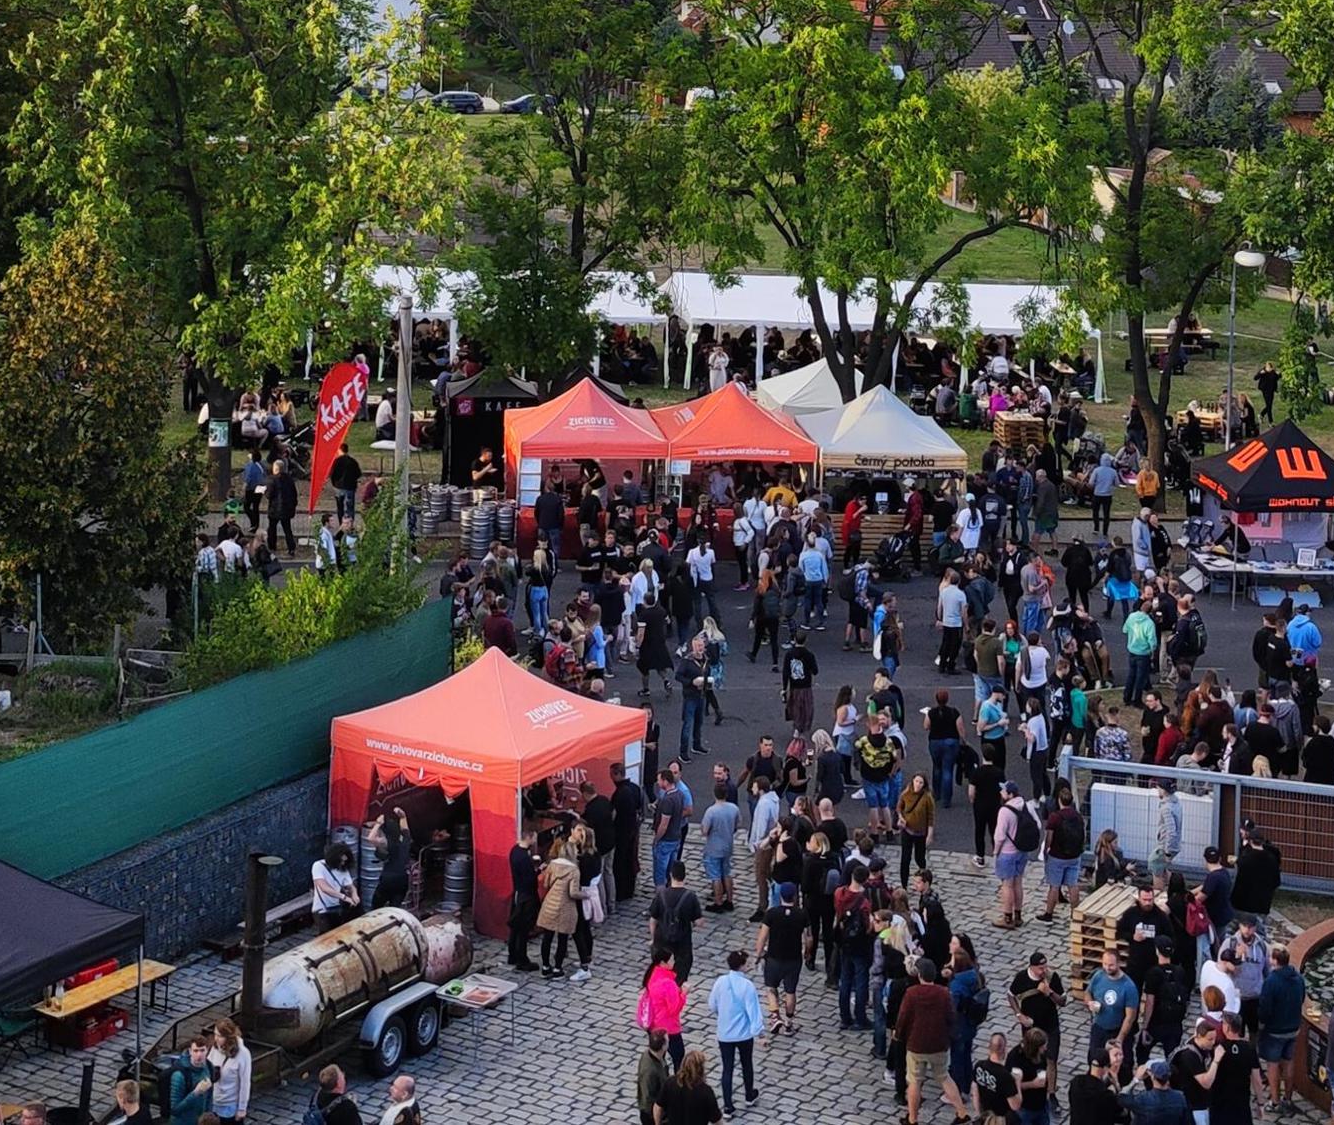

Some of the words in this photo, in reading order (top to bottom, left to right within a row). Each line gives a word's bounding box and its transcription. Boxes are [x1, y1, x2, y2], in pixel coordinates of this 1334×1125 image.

[320, 372, 366, 428] KAFE
[568, 416, 616, 426] ZICHOVEC
[524, 699, 574, 723] ZICHOVEC
[366, 738, 484, 773] www.pivovarzichovec.cz
